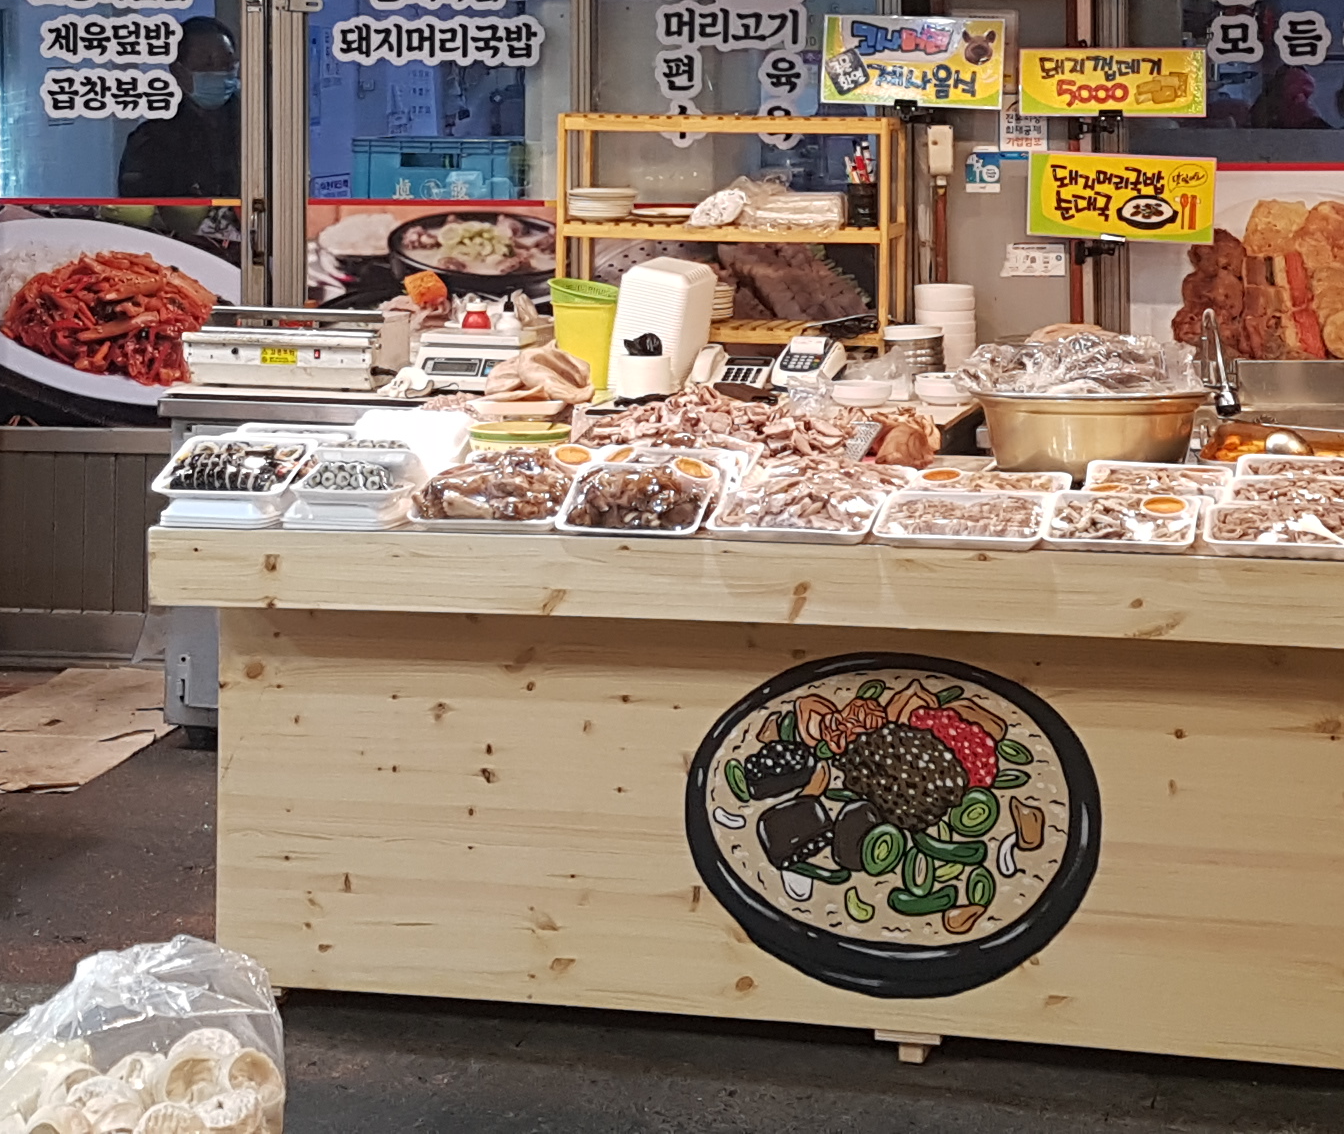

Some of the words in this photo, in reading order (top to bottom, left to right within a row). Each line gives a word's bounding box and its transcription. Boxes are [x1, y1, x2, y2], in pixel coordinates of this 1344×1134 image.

[46, 21, 177, 57] 제육덮밥
[339, 22, 539, 59] 돼지머리국밥
[664, 9, 801, 46] 머리고기
[851, 20, 955, 56] 고사머리
[46, 76, 177, 113] 곱창볶음
[1056, 79, 1130, 108] 5000
[1050, 164, 1165, 196] 돼지머리국밥
[1054, 190, 1113, 223] 순대국
